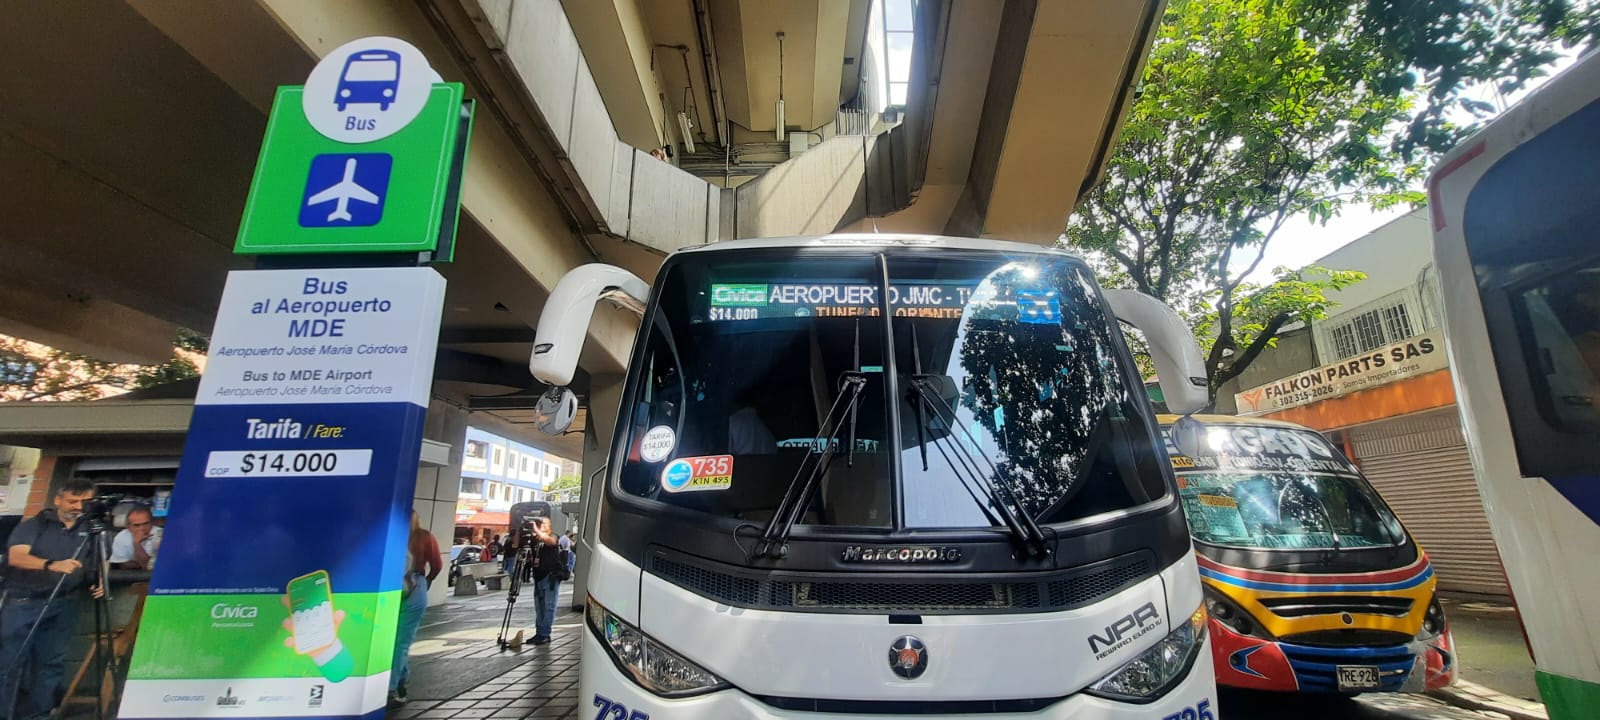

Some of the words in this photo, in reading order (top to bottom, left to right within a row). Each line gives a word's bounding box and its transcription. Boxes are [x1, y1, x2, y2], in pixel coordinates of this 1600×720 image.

[345, 116, 376, 130] Bus
[303, 277, 348, 295] Bus
[769, 286, 899, 304] AEROPUERO
[902, 287, 942, 304] JMC
[251, 298, 269, 314] al
[275, 298, 392, 316] Aeropuerto
[710, 306, 758, 320] $14.000
[288, 318, 346, 338] MDE
[216, 346, 284, 358] Aeropuerto
[286, 345, 316, 356] José
[318, 344, 353, 355] María
[356, 344, 408, 354] Córdova
[242, 370, 268, 382] Bus
[272, 371, 286, 381] to
[290, 370, 322, 381] MDE
[325, 369, 372, 382] Airport
[1265, 372, 1322, 400] FALKON
[1326, 353, 1386, 382] PARTS
[1391, 338, 1434, 362] SAS
[1342, 378, 1366, 389] Somos
[1367, 362, 1420, 383] Importadores
[216, 386, 278, 398] Aeropuerto
[280, 385, 308, 396] José
[345, 384, 392, 395] Córdova
[1279, 396, 1294, 406] 302
[1295, 384, 1334, 403] 315-2026
[246, 418, 302, 440] Tarifa
[312, 424, 346, 438] Fare:
[210, 467, 230, 476] COP
[240, 452, 338, 474] $14.000
[694, 457, 729, 476] 735
[692, 477, 710, 485] KTN
[844, 546, 957, 562] Marcopolo
[1096, 638, 1132, 660] REWARD
[1132, 623, 1156, 640] EURO
[1162, 698, 1214, 720] 35
